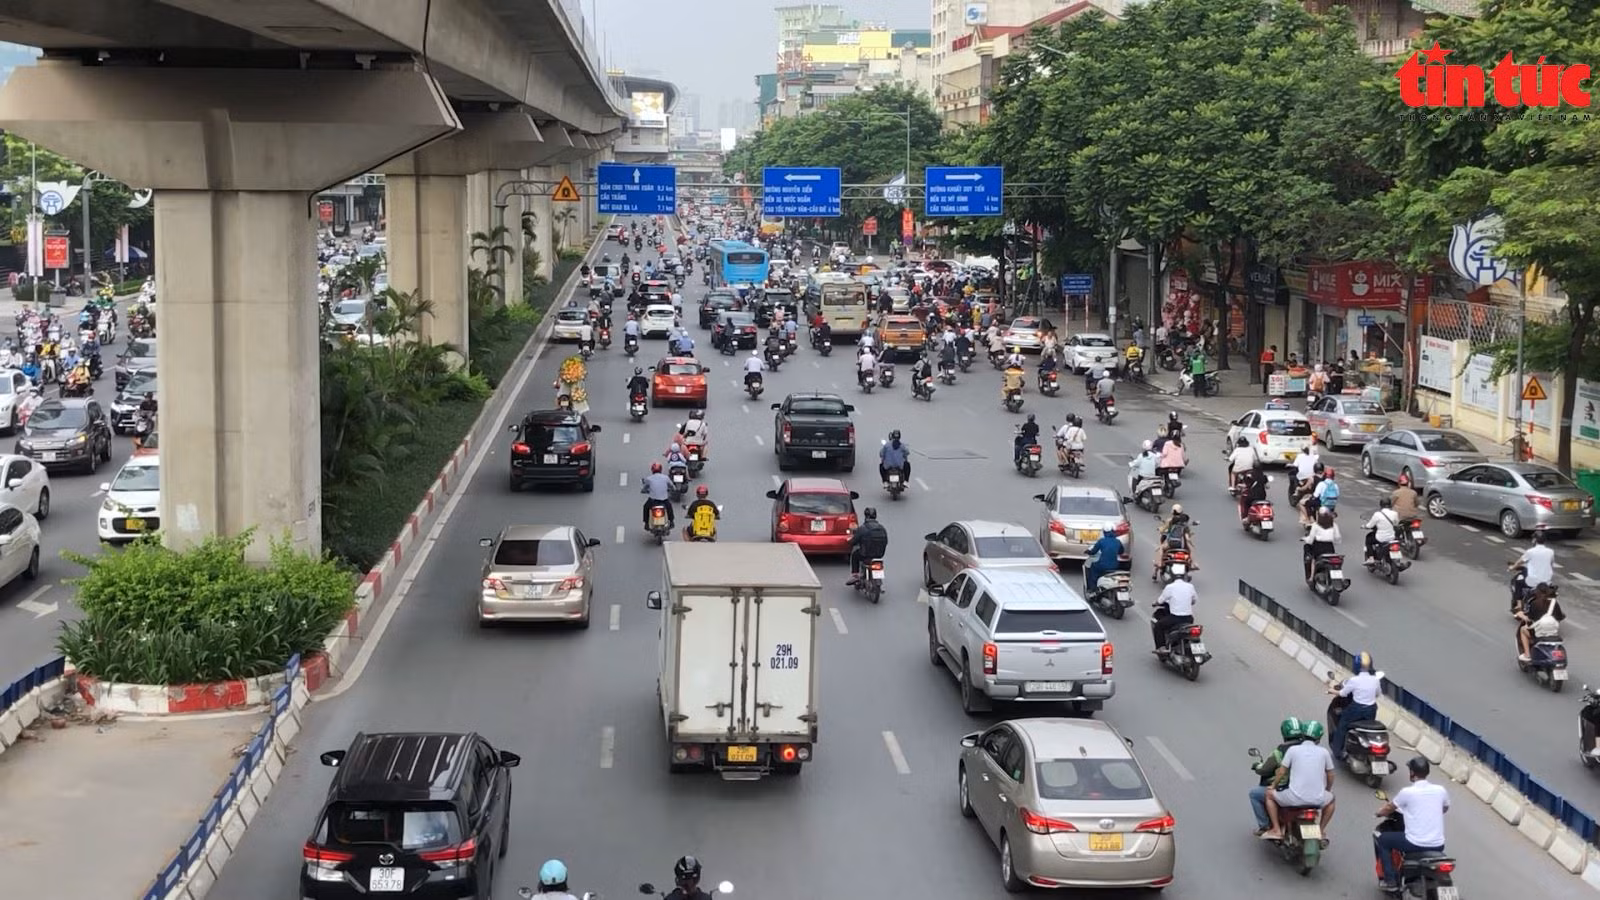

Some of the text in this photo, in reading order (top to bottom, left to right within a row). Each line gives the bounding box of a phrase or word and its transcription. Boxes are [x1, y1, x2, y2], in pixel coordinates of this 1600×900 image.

[1373, 273, 1425, 288] MIXE
[776, 643, 792, 656] 29H
[770, 656, 799, 669] 021.09
[379, 867, 397, 879] 30F
